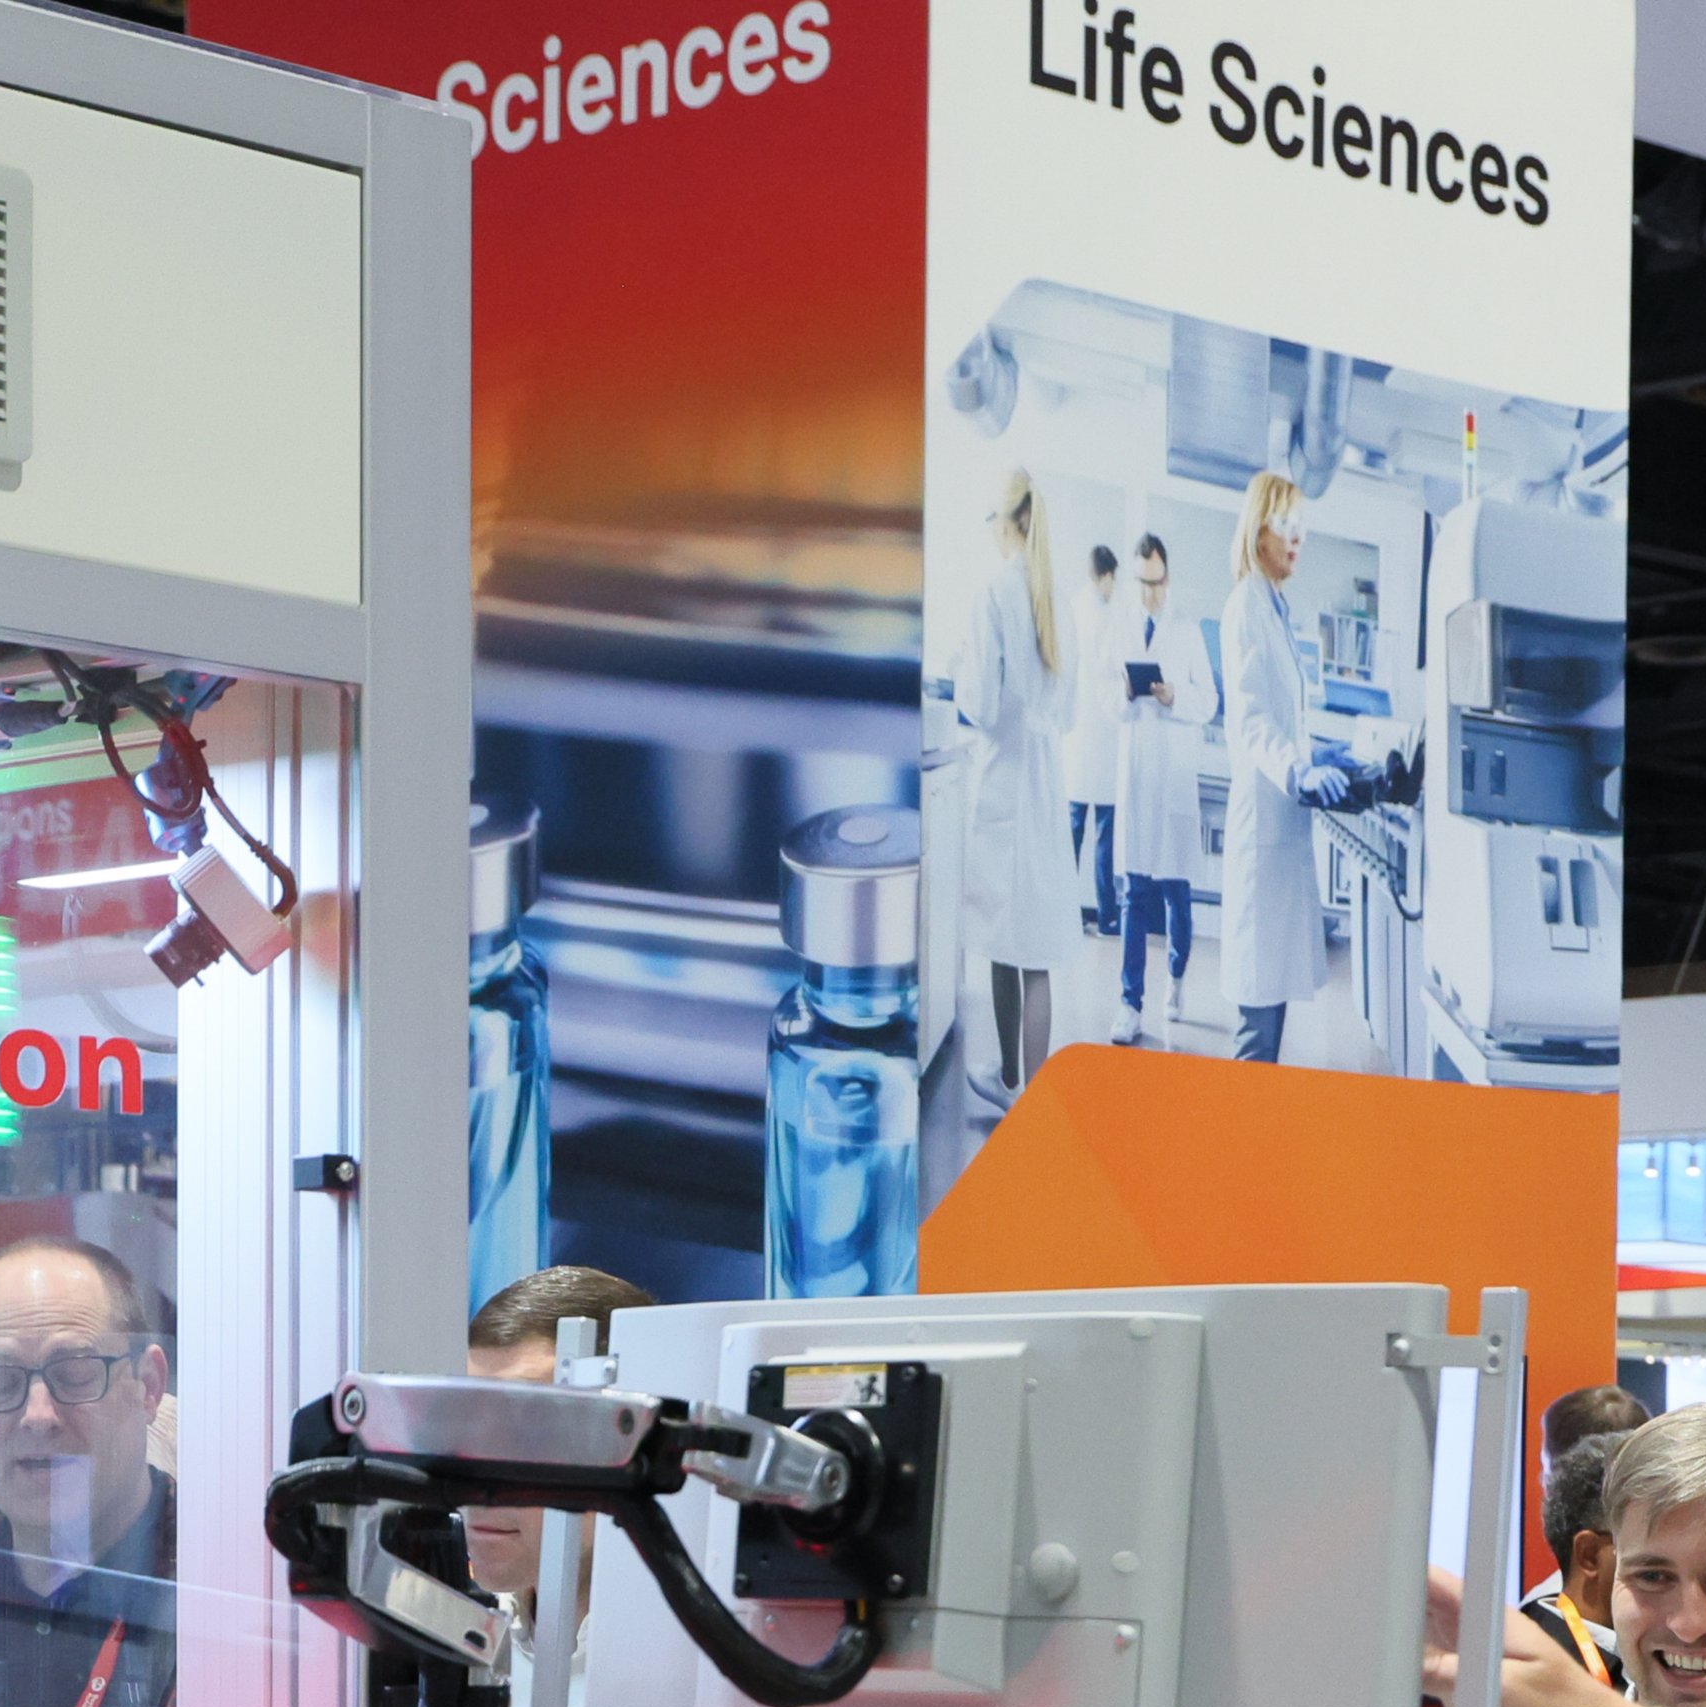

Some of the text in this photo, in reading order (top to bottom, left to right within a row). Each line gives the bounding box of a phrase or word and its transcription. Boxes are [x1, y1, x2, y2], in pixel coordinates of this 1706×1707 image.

[436, 1, 831, 158] Sciences
[1031, 0, 1552, 227] Life Sciences
